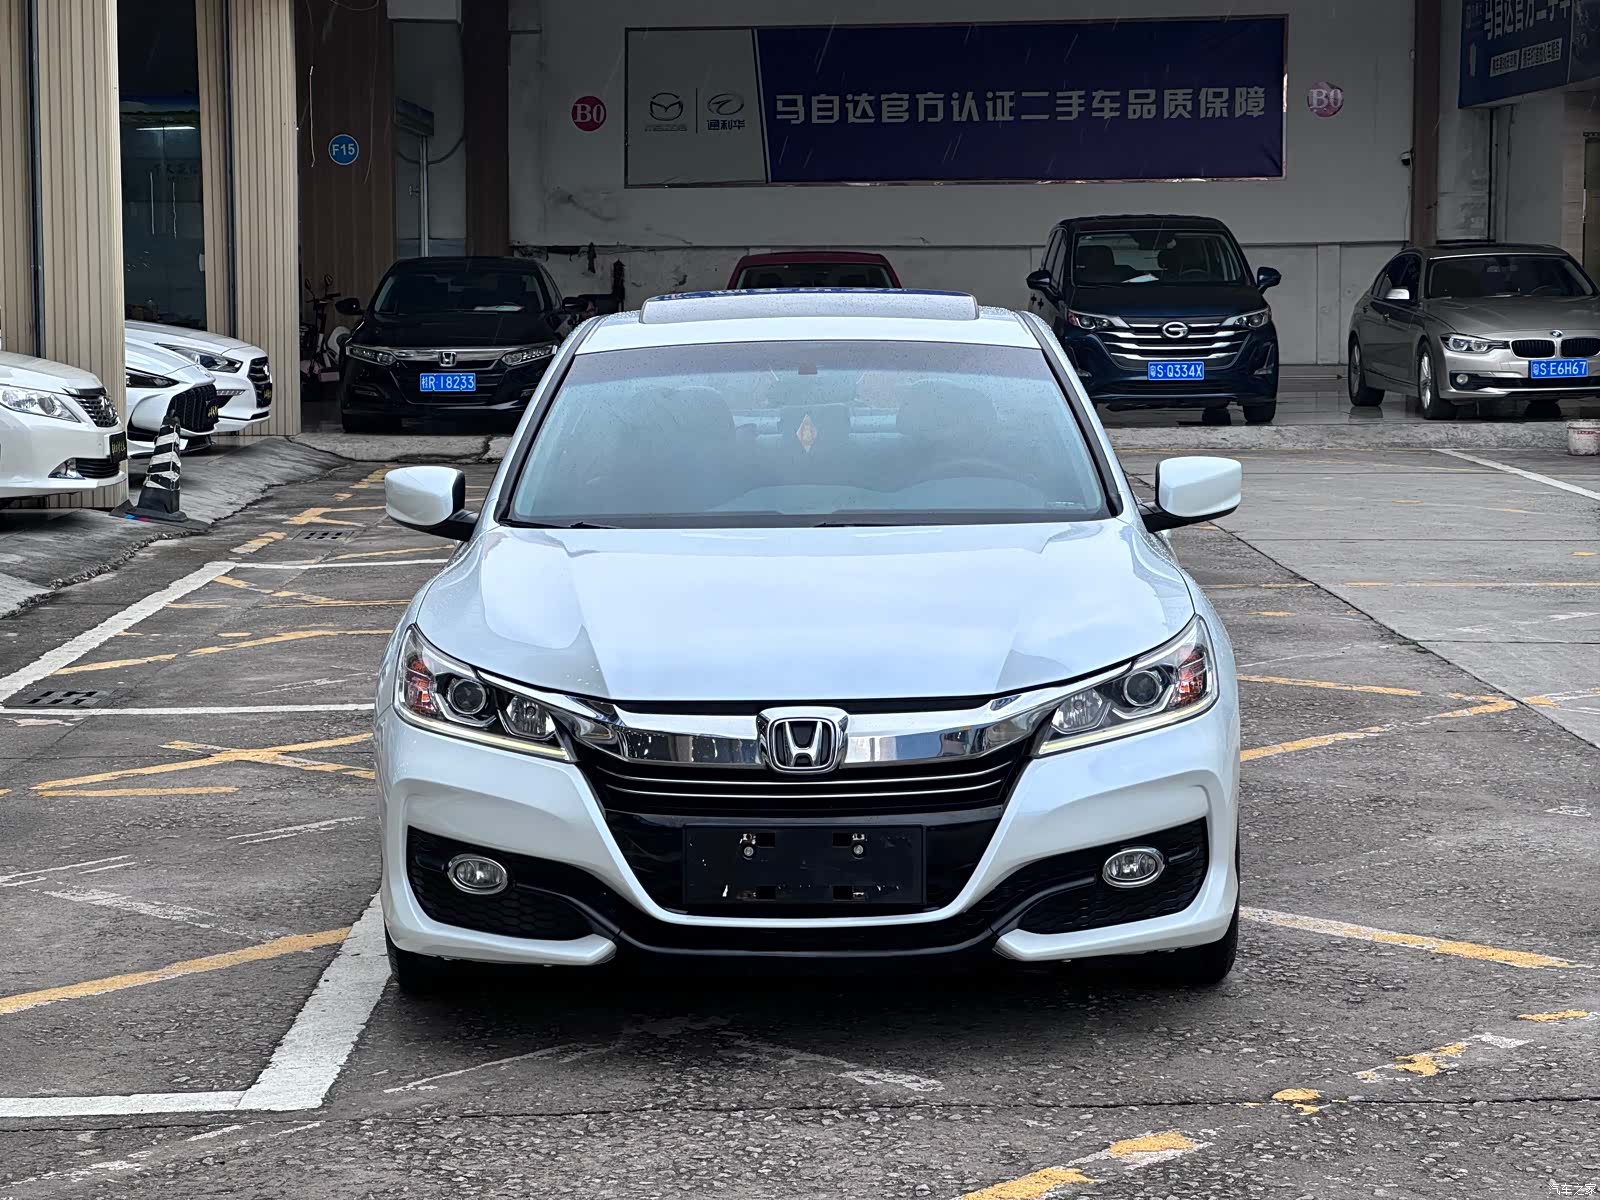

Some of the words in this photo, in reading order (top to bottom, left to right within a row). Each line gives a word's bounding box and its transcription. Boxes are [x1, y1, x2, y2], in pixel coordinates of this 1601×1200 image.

[775, 86, 1266, 125] 马自达官方认证二手车品质保障
[707, 119, 745, 131] 通利华
[332, 143, 356, 157] F15
